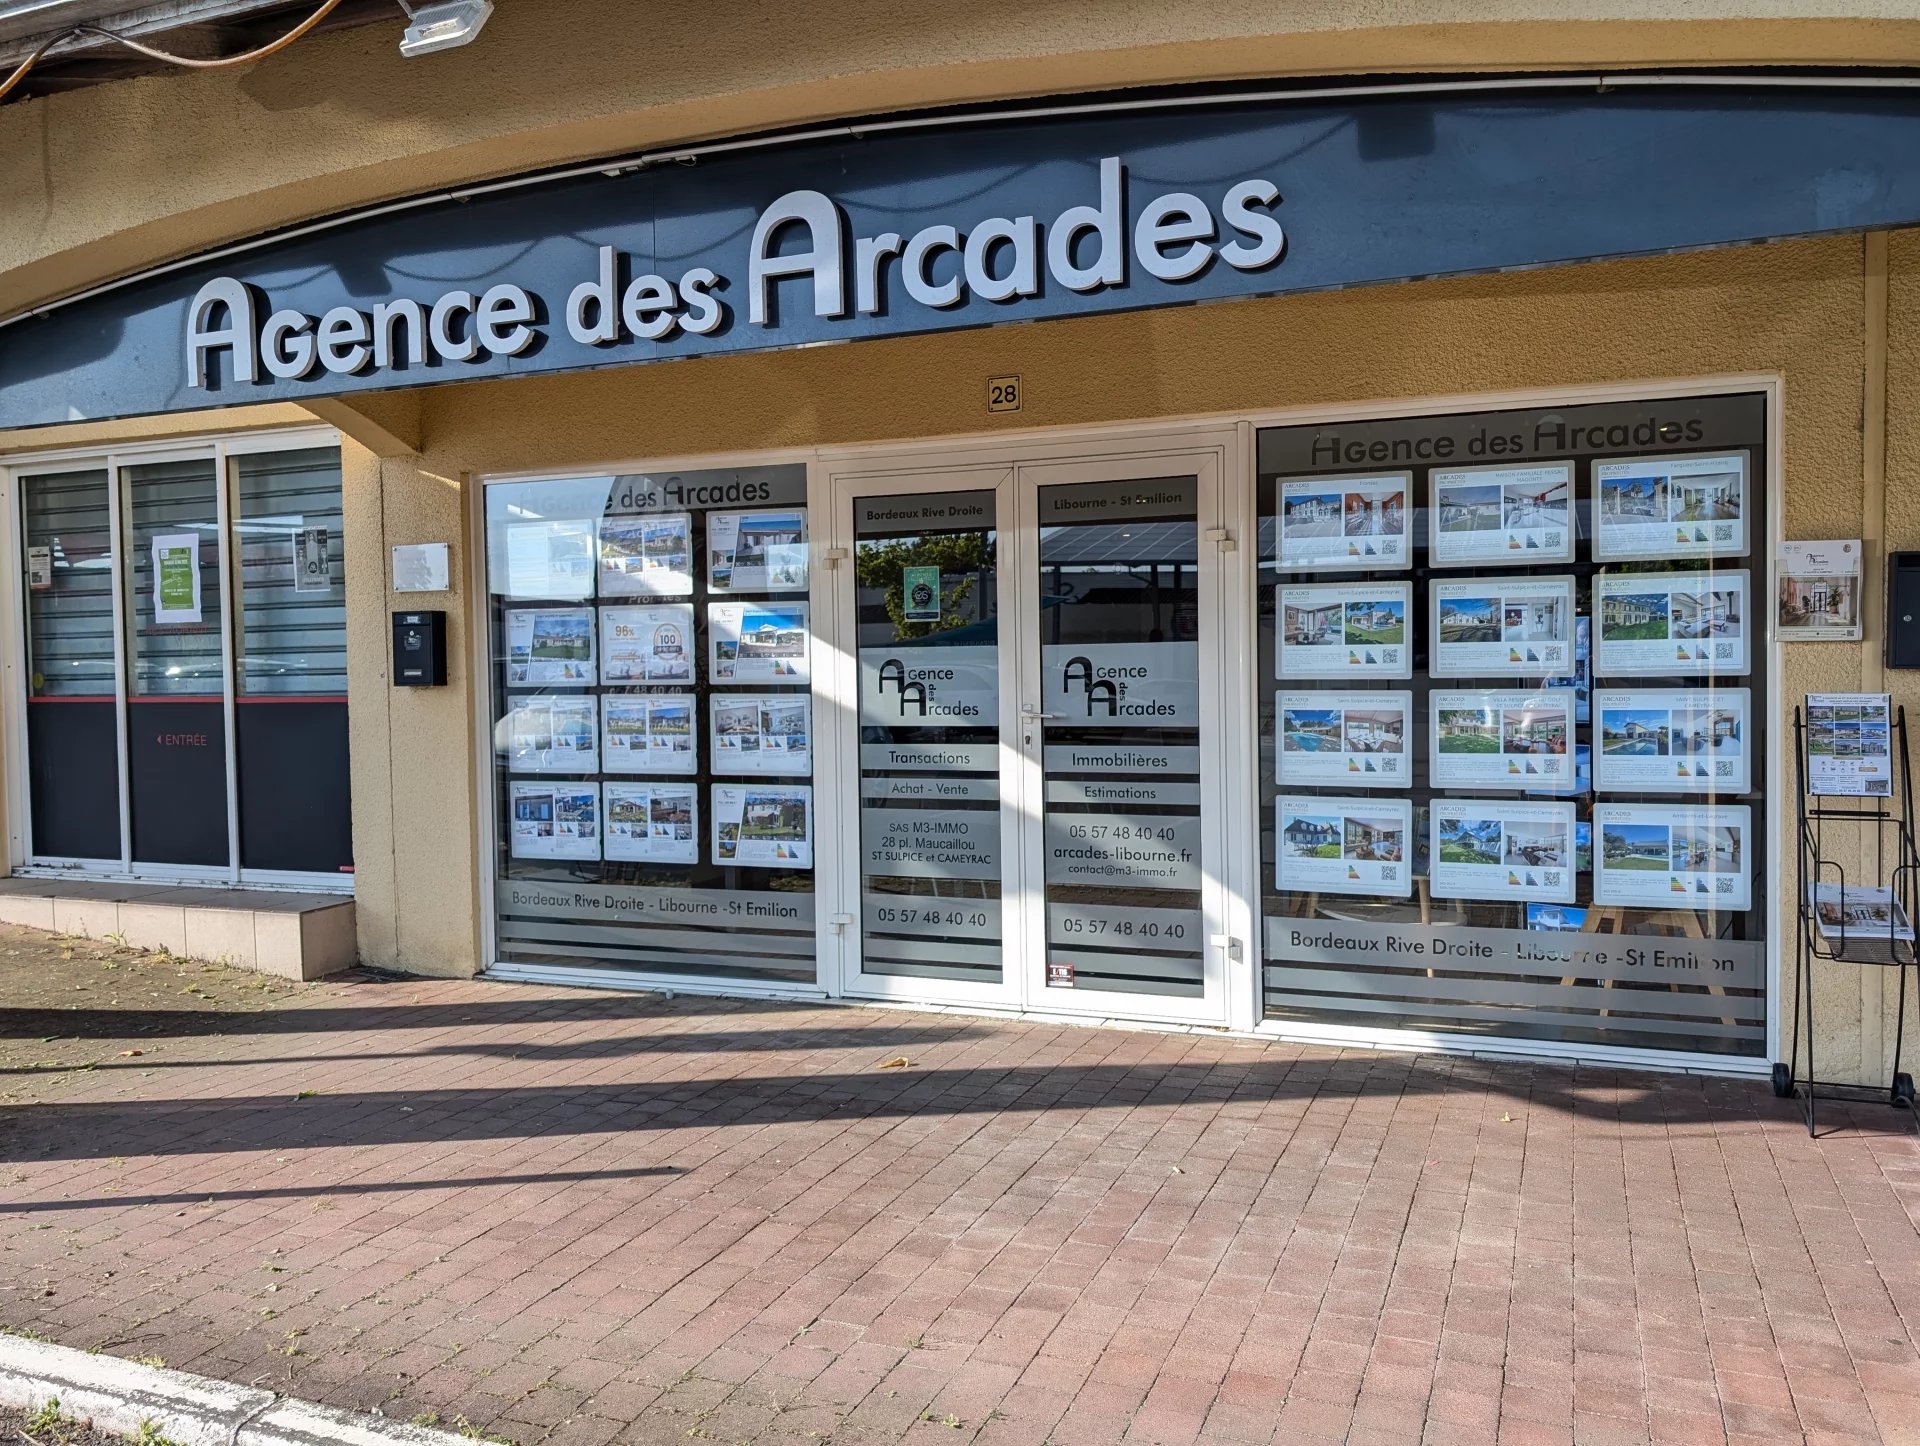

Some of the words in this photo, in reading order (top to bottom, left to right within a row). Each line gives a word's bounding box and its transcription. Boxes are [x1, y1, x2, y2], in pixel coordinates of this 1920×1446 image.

[566, 246, 721, 345] des
[749, 157, 1285, 325] Arcades
[991, 384, 1017, 405] 28
[1468, 429, 1524, 455] des
[1533, 415, 1704, 452] Arcades
[621, 485, 656, 508] des
[664, 476, 770, 505] Arcades
[1054, 497, 1108, 510] Libourne
[1120, 495, 1132, 507] St
[1135, 492, 1183, 506] Emilion
[867, 509, 919, 521] Bordeaux
[922, 507, 945, 519] Rive
[949, 505, 983, 517] Droite
[660, 634, 676, 645] 100
[900, 681, 979, 717] Arcades
[928, 683, 936, 702] des
[1088, 680, 1176, 717] Arcades
[1119, 682, 1128, 701] des
[165, 733, 207, 746] ENTRÉE
[889, 750, 970, 765] Transactions
[1072, 753, 1168, 768] Immobilières
[892, 783, 924, 795] Achat
[936, 783, 969, 796] Vente
[1084, 785, 1156, 799] Estimations
[889, 823, 909, 833] SAS
[913, 822, 969, 834] M3-IMMO
[1069, 825, 1087, 838] 05
[1091, 826, 1108, 839] 57
[1113, 826, 1130, 840] 48
[1135, 827, 1152, 840] 40
[1157, 827, 1175, 841] 40
[881, 837, 896, 848] 28
[899, 837, 912, 851] pl.
[915, 837, 975, 850] Maucaillou
[872, 851, 884, 861] ST
[885, 851, 923, 862] SULPICE
[926, 853, 935, 862] et
[938, 852, 991, 865] CAMEYRAC
[1054, 845, 1192, 863] arcades-libourne.fr
[1068, 863, 1178, 877] contact@m3-immo.fr
[512, 891, 571, 908] Bordeaux
[574, 894, 600, 910] Rive
[604, 895, 644, 911] Droite
[659, 898, 718, 915] Libourne
[746, 901, 798, 919] Emilion
[878, 908, 895, 922] 05
[900, 909, 917, 923] 57
[923, 910, 940, 925] 48
[945, 911, 963, 926] 40
[968, 912, 986, 927] 40
[1064, 918, 1082, 933] 05
[1089, 920, 1107, 934] 57
[1114, 921, 1133, 936] 48
[1139, 922, 1158, 937] 40
[1164, 924, 1184, 938] 40
[1290, 931, 1380, 951] Bordeaux
[1386, 936, 1424, 954] Rive
[1432, 938, 1493, 957] Droite
[1653, 950, 1735, 972] Emilon
